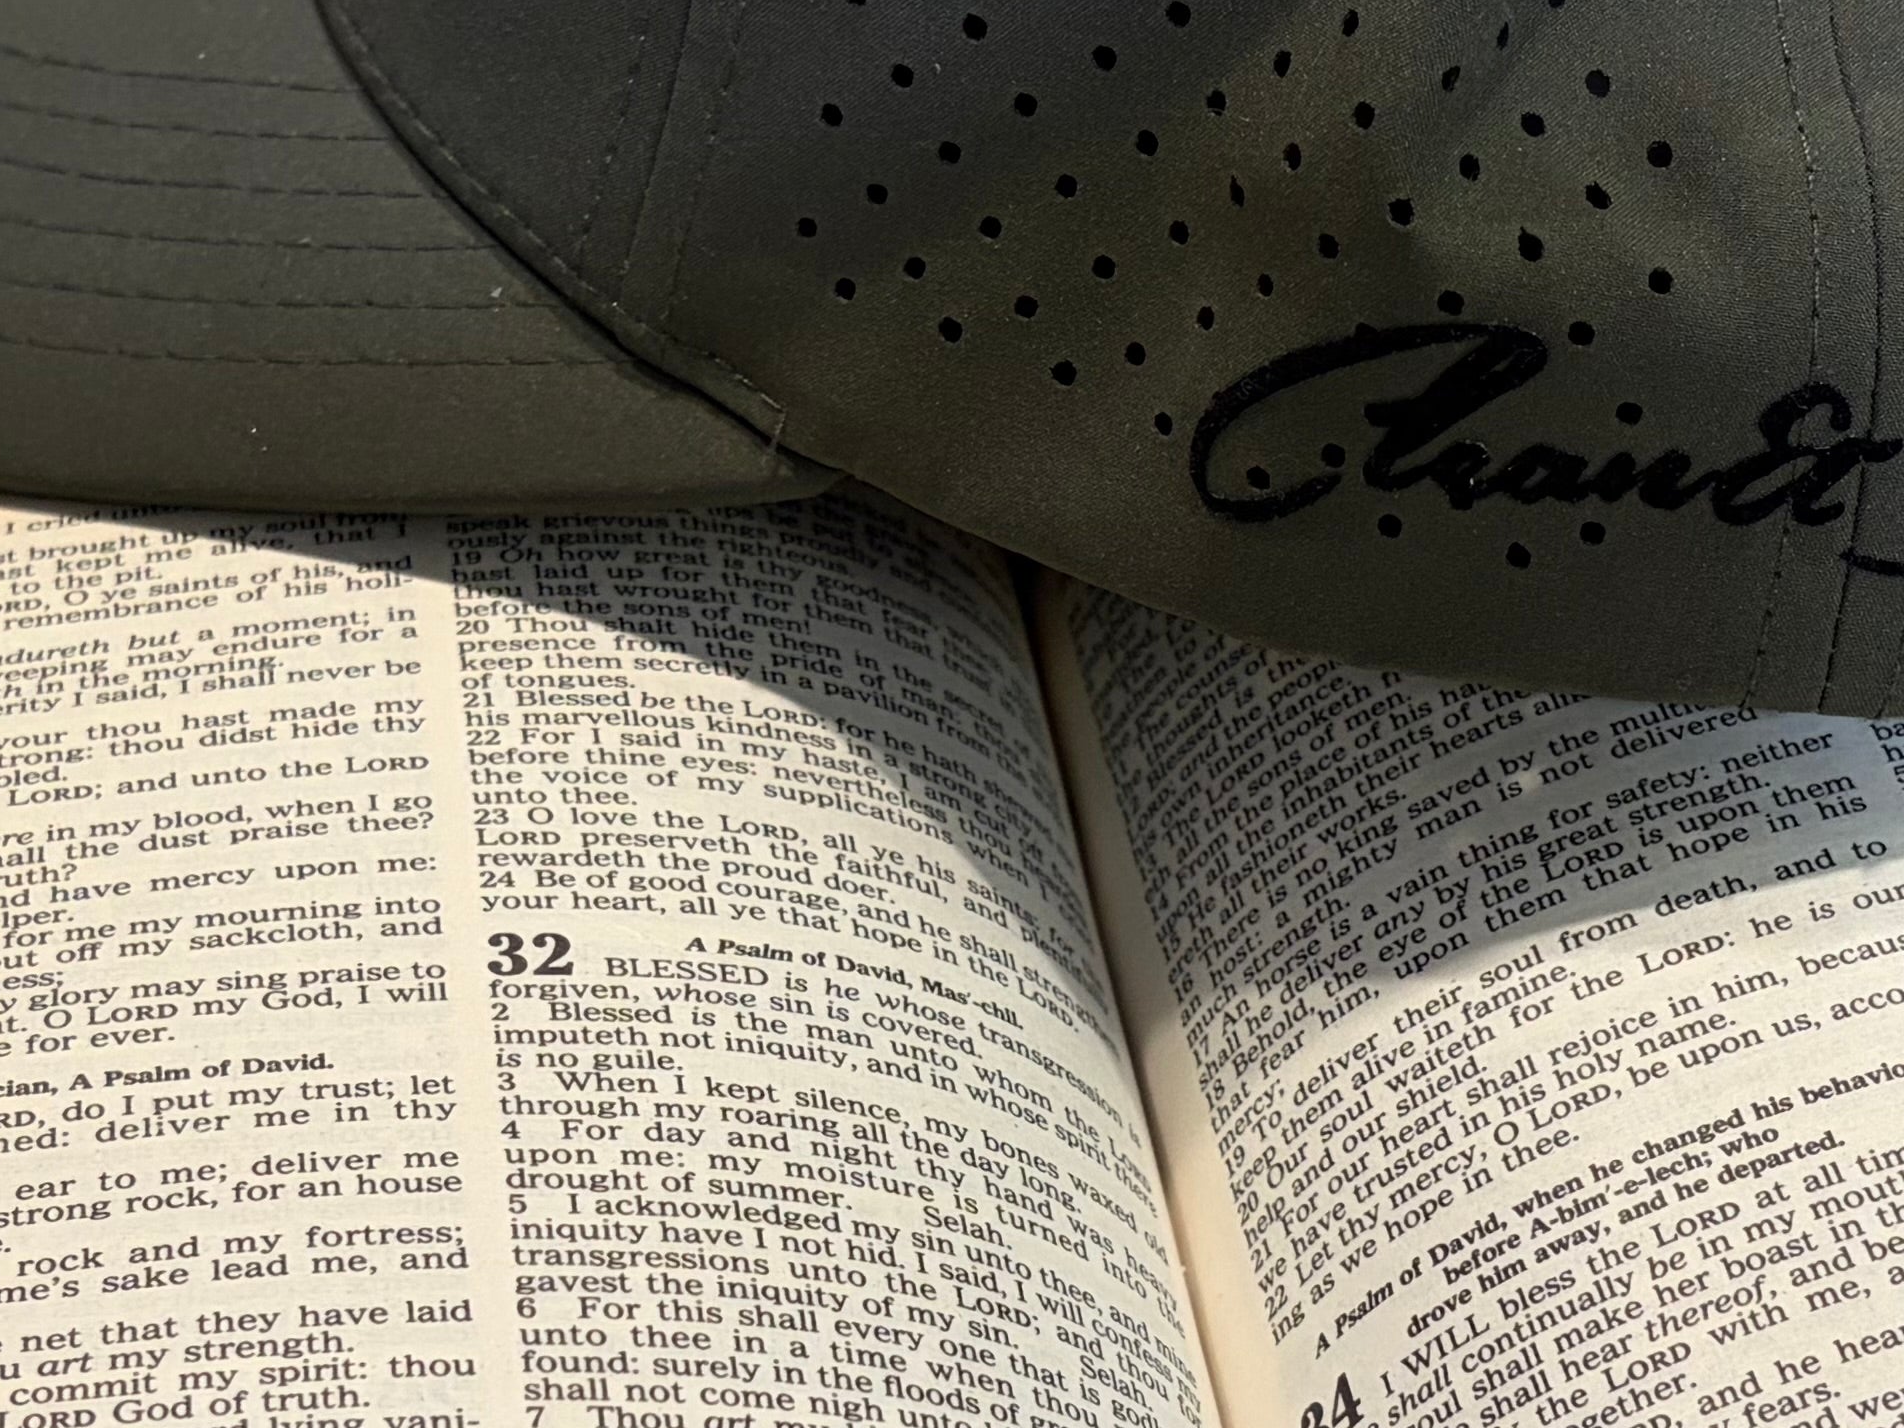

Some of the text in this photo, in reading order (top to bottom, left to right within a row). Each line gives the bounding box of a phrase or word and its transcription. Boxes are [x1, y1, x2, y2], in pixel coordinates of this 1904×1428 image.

[487, 932, 574, 976] 32
[67, 1072, 93, 1091] A
[102, 1064, 191, 1088] Psalm
[200, 1058, 231, 1078] of
[240, 1051, 335, 1075] David.
[60, 1098, 106, 1122] do
[120, 1094, 134, 1116] I
[151, 1088, 213, 1116] put
[227, 1086, 285, 1106] my
[298, 1077, 395, 1107] trust;
[409, 1073, 456, 1095] let
[1314, 1331, 1331, 1360] A
[1333, 1280, 1395, 1340] Psalm
[1398, 1255, 1423, 1286] of
[1425, 1210, 1508, 1268] David,
[1510, 1175, 1585, 1218] when
[1587, 1158, 1624, 1184] he
[1630, 1106, 1747, 1165] changed
[1748, 1095, 1794, 1121] his
[19, 1326, 82, 1353] net
[98, 1316, 179, 1345] that
[194, 1310, 281, 1335] they
[297, 1304, 388, 1328] have
[404, 1298, 473, 1323] laid
